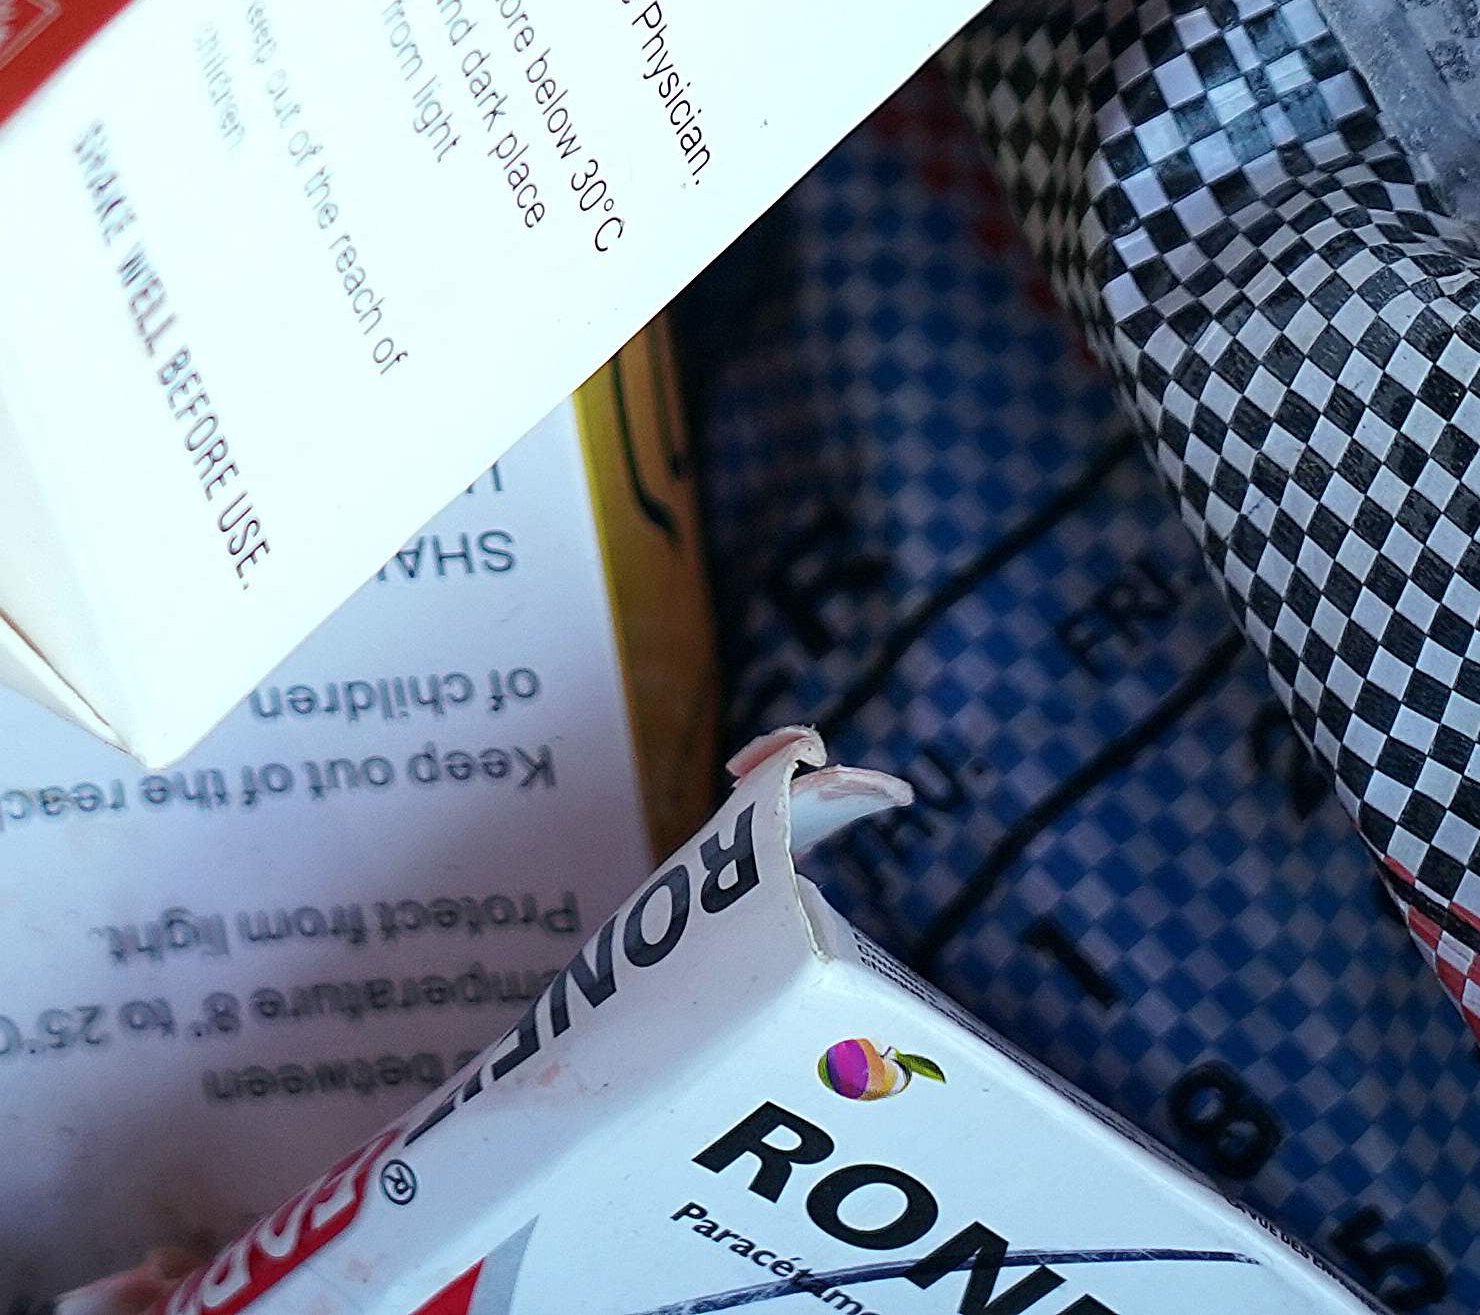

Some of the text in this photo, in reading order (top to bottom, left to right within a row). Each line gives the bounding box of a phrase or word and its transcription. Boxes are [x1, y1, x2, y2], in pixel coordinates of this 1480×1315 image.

[631, 0, 711, 186] Physician.
[491, 131, 546, 229] place
[570, 158, 624, 253] 30°C
[407, 743, 556, 788] Keep
[691, 1100, 1120, 1315] RON
